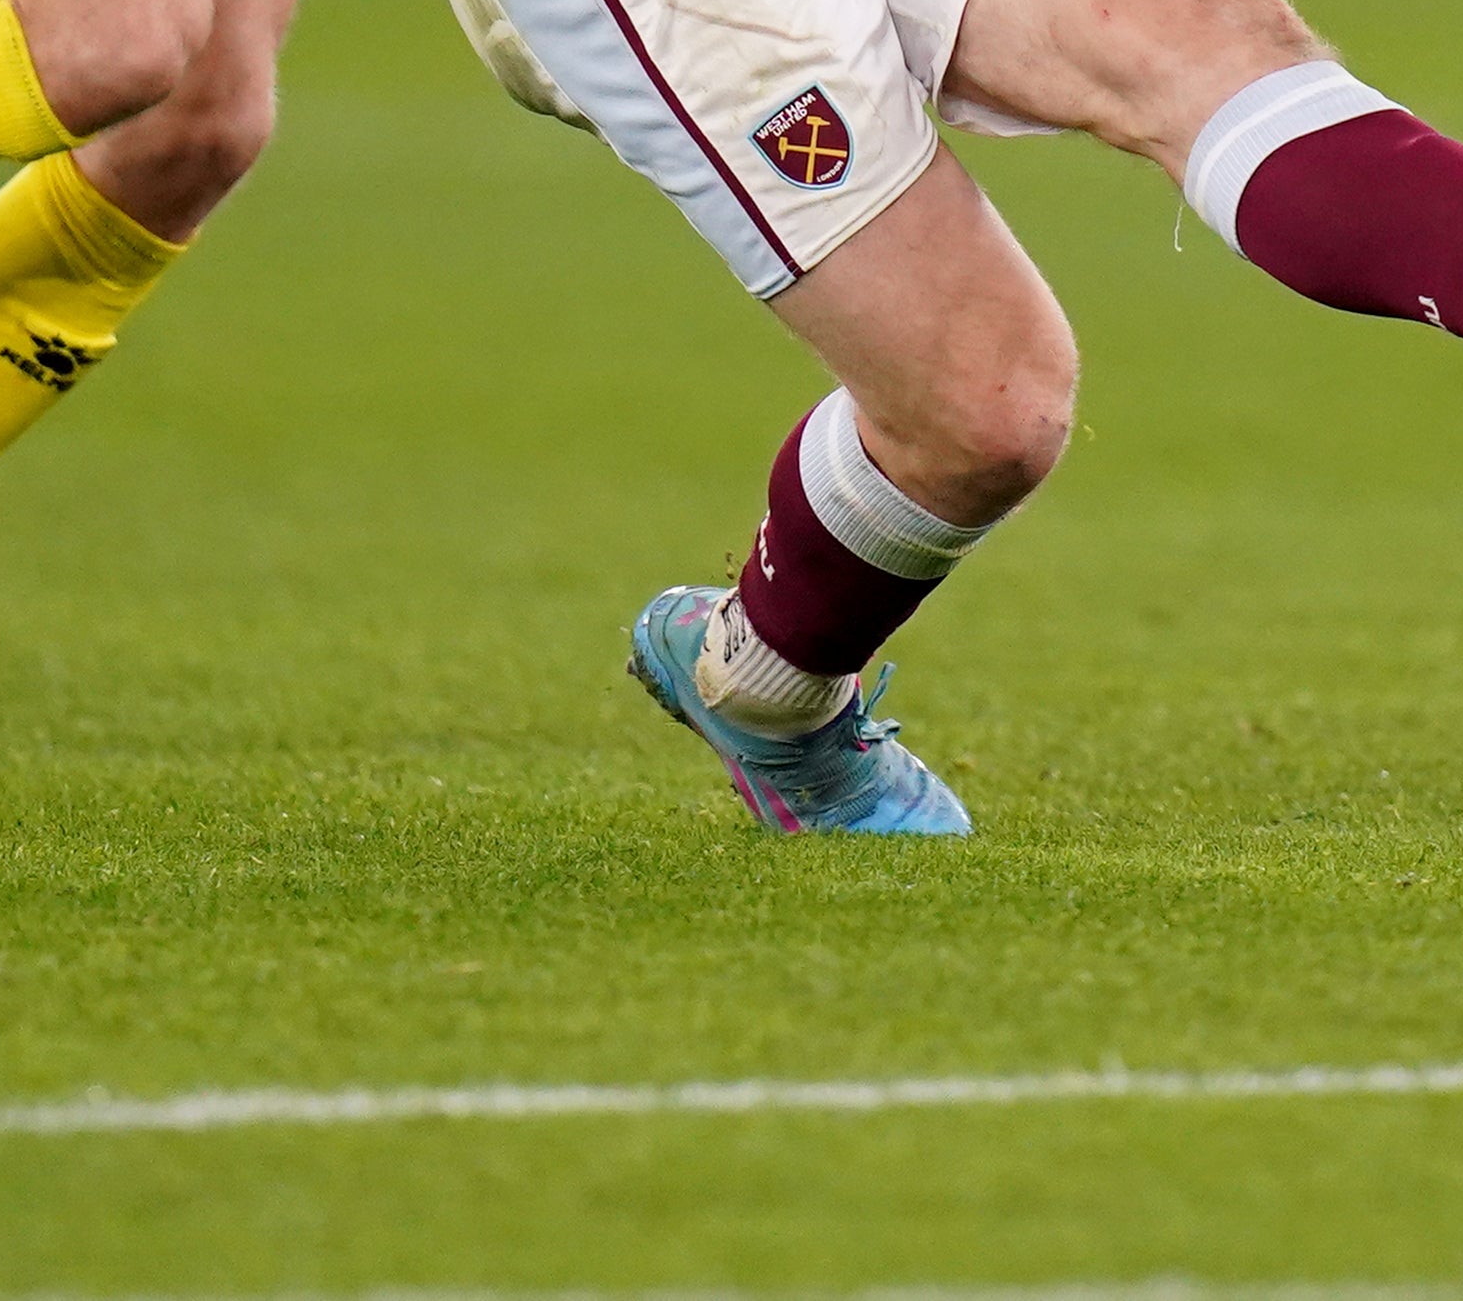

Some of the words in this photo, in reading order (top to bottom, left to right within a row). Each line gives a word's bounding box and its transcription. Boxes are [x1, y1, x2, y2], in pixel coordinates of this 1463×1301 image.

[755, 111, 787, 140] WEST
[784, 93, 817, 119] HAM
[772, 107, 808, 137] UNITED
[816, 160, 844, 183] LONDON
